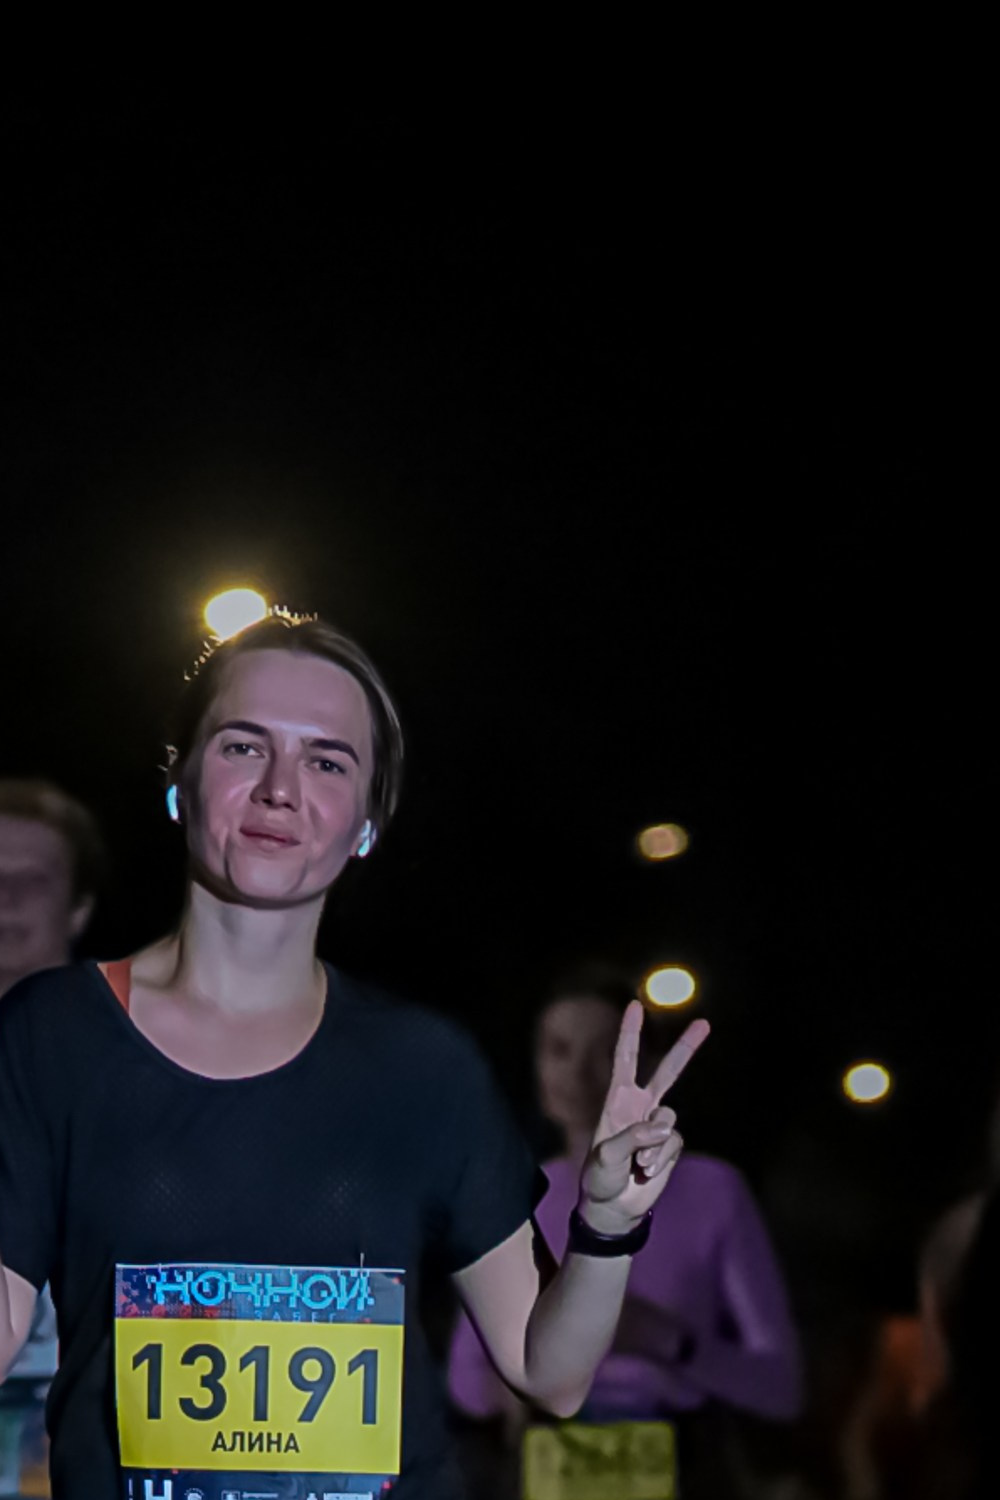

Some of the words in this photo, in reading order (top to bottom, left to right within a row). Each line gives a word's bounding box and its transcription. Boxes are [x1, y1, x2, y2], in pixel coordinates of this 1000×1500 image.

[148, 1268, 374, 1311] НОЧНОЙ
[132, 1343, 378, 1425] 13191
[211, 1431, 300, 1453] АЛИНА
